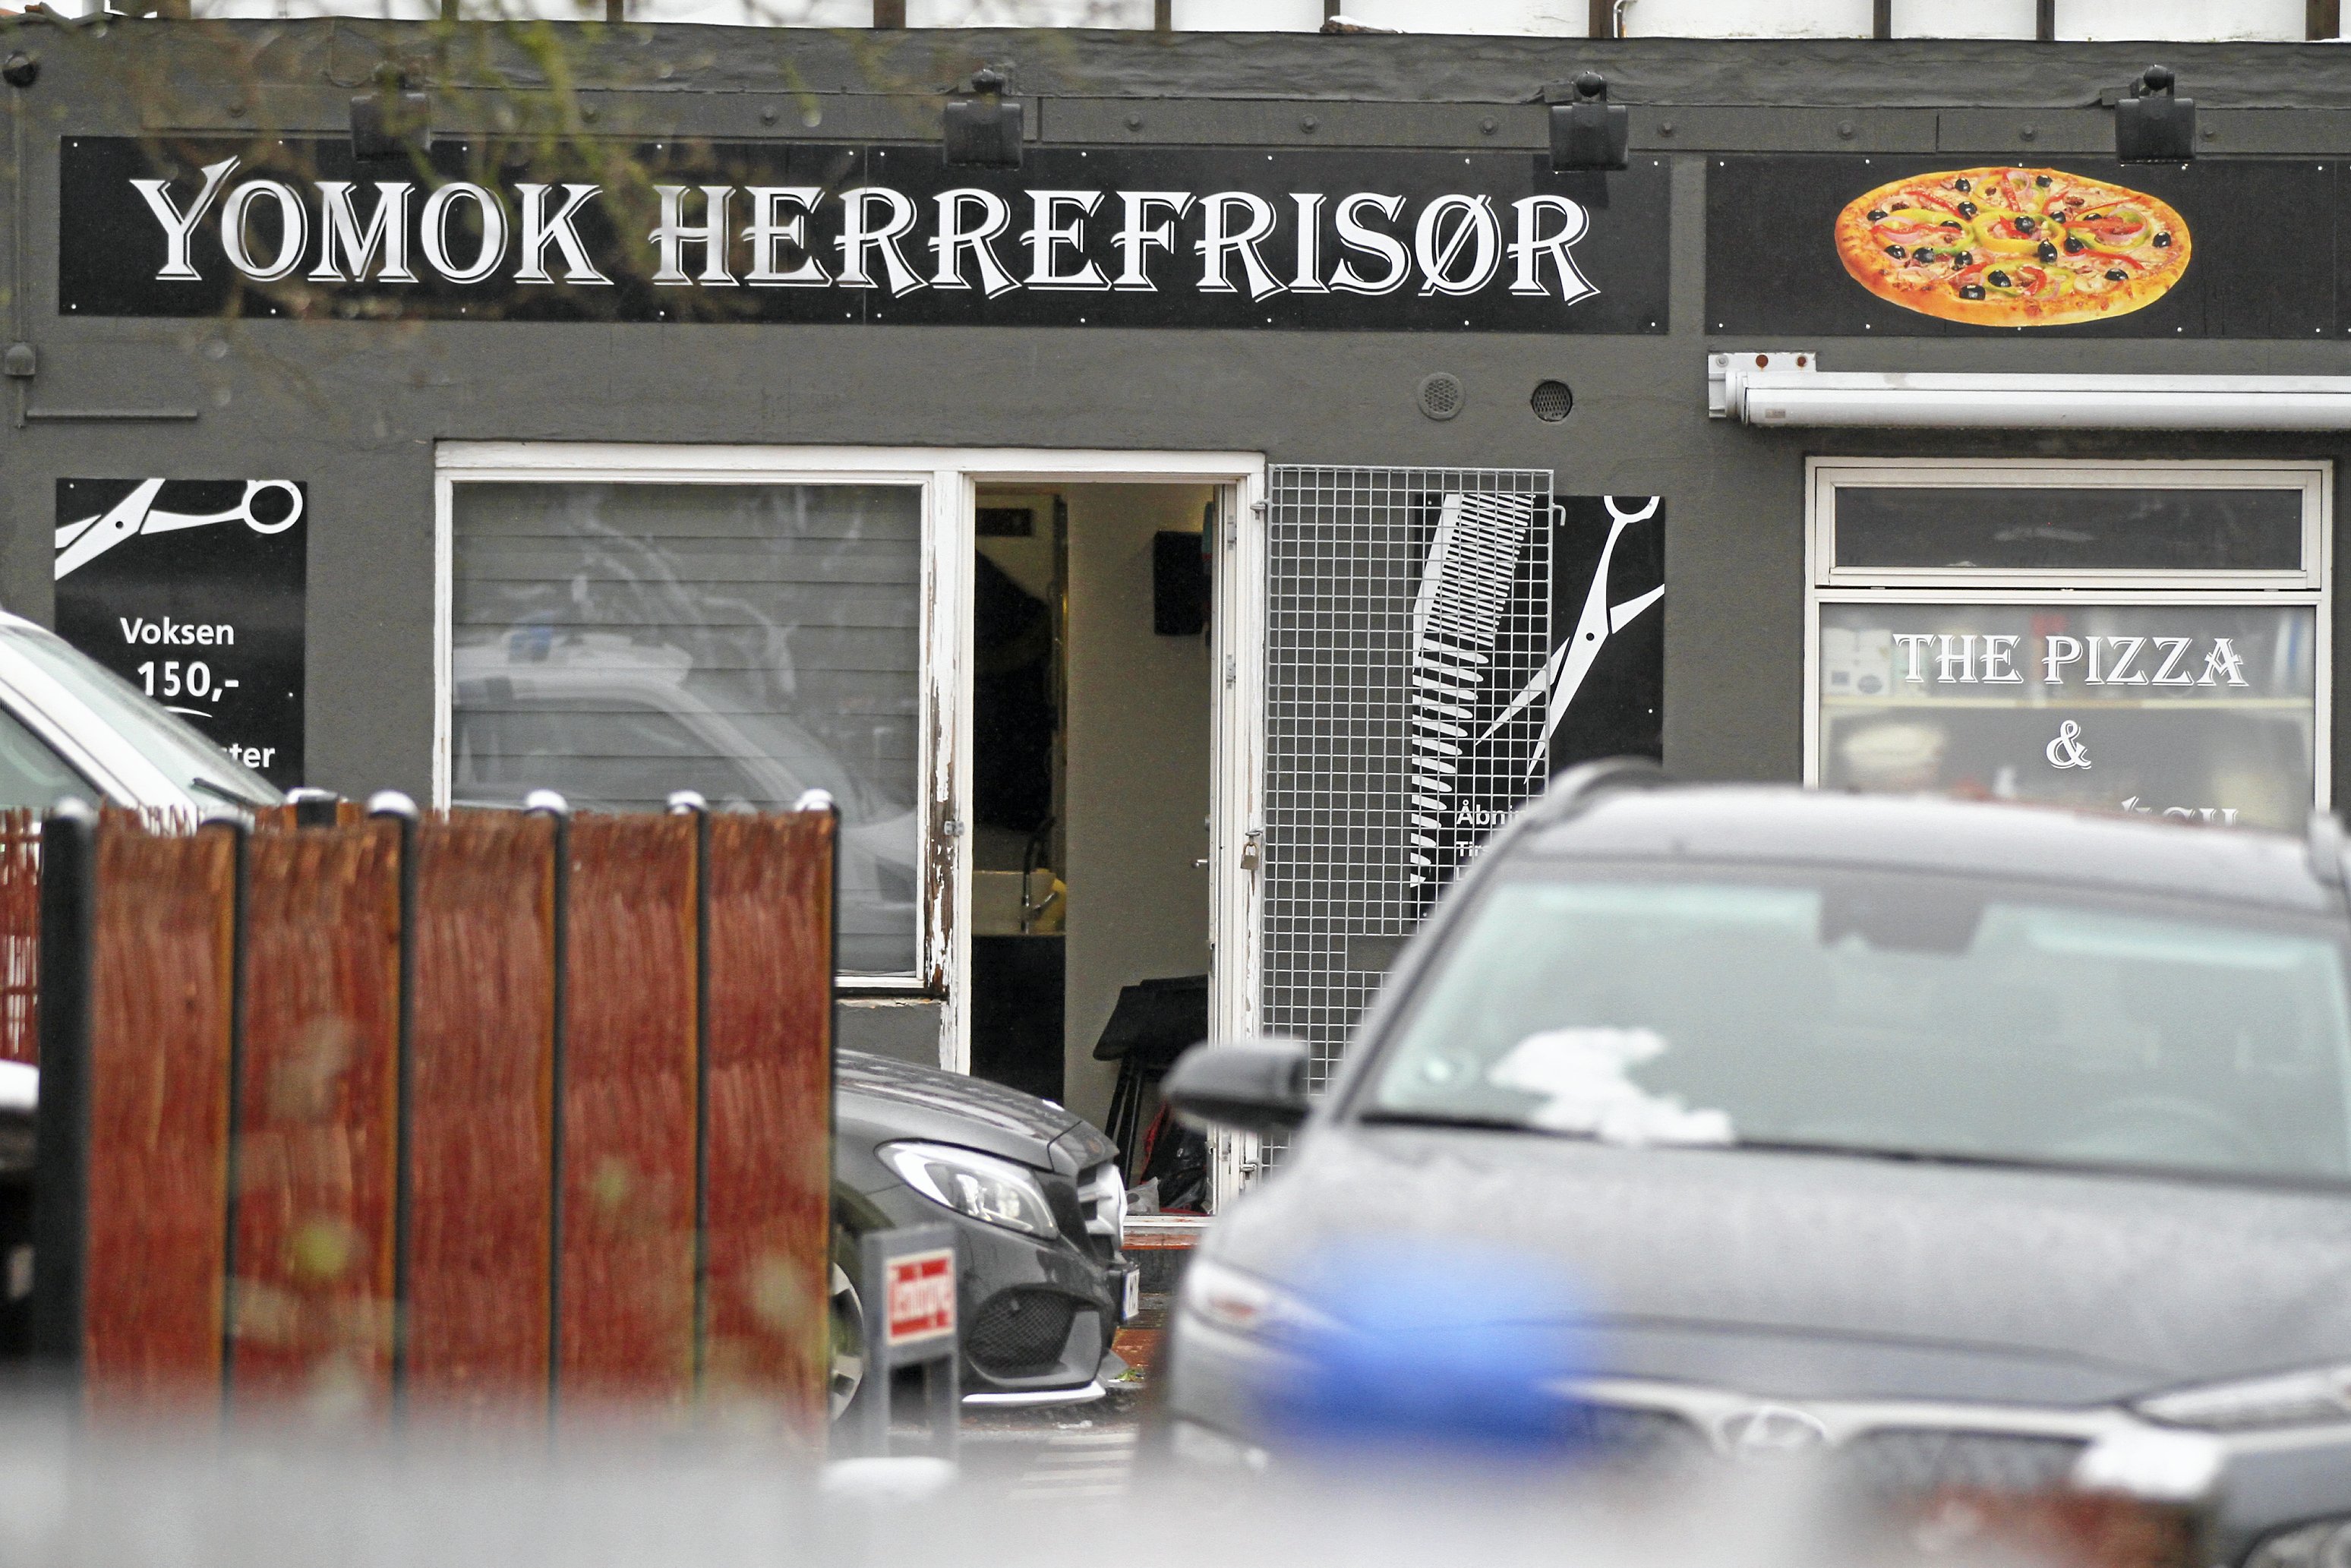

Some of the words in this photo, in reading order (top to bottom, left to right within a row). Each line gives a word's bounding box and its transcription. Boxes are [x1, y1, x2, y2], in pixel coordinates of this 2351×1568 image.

[128, 155, 614, 286] YOMOK
[647, 184, 1602, 306] HERREFRISØR
[120, 616, 235, 645] Voksen
[137, 661, 239, 702] 150,-
[1892, 633, 2024, 684] THE
[2041, 634, 2250, 687] PIZZA
[2046, 719, 2092, 770] &
